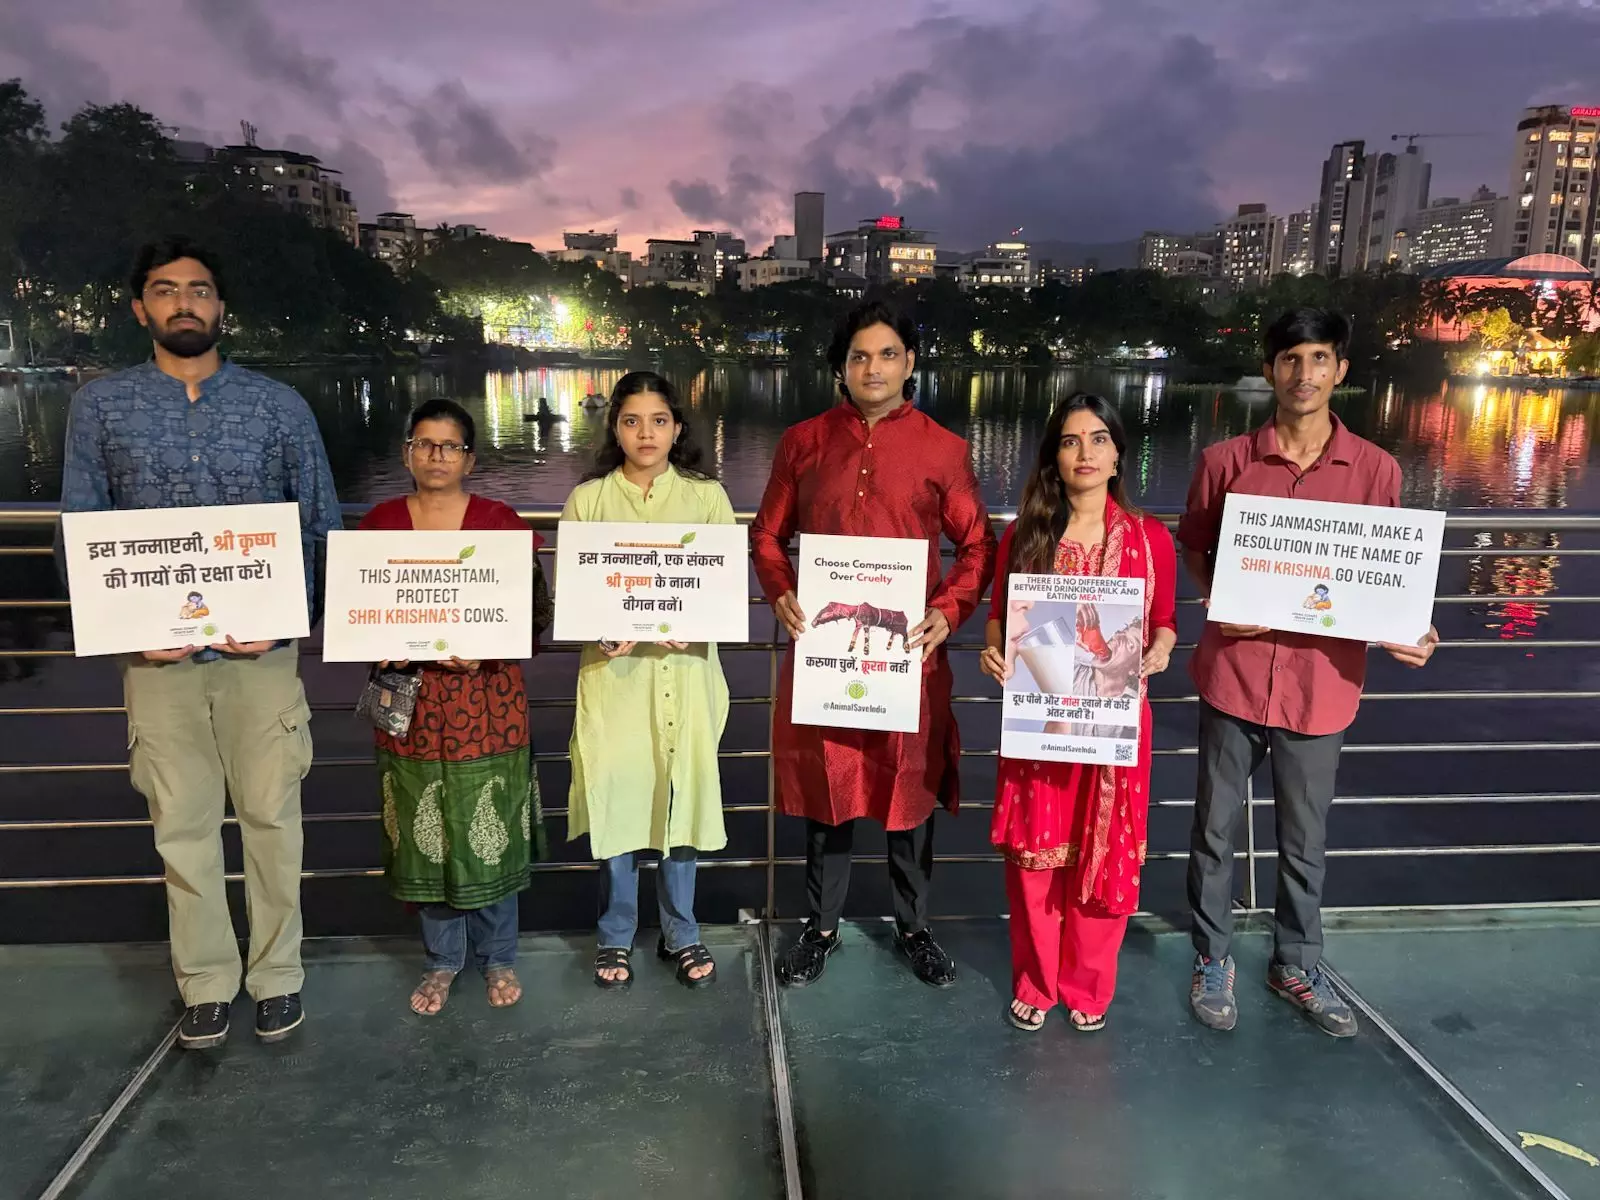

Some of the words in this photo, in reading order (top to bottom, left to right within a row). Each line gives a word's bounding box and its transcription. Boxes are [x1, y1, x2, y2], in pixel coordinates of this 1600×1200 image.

[1239, 511, 1267, 526] THIS
[1269, 514, 1367, 539] JANMASHTAMI,
[1371, 524, 1411, 541] MAKE
[1414, 528, 1424, 542] A
[87, 541, 116, 560] इस
[120, 532, 208, 556] जन्माष्टमी,
[214, 530, 234, 551] श्री
[237, 532, 277, 556] कृष्ण
[1233, 533, 1312, 555] RESOLUTION
[1315, 542, 1329, 557] IN
[1333, 544, 1358, 560] THE
[1361, 546, 1401, 564] NAME
[1404, 551, 1423, 566] OF
[578, 552, 597, 565] इस
[601, 551, 661, 567] जन्माष्टमी,
[664, 554, 684, 566] एक
[686, 552, 725, 566] संकल्प
[814, 557, 850, 568] Choose
[852, 560, 912, 571] Compassion
[103, 567, 127, 589] की
[131, 565, 172, 587] गायों
[173, 563, 196, 584] की
[199, 565, 234, 583] रक्षा
[237, 560, 271, 579] करें।
[360, 569, 391, 583] THIS
[395, 568, 499, 585] JANMASHTAMI,
[829, 572, 854, 581] Over
[856, 573, 893, 585] Cruelty
[1241, 557, 1271, 573] SHRI
[1357, 570, 1406, 588] VEGAN.
[606, 573, 621, 588] श्री
[624, 575, 652, 593] कृष्ण
[655, 574, 667, 588] के
[669, 577, 700, 589] नाम।
[1014, 583, 1052, 592] BETWEEN
[1054, 585, 1095, 593] DRINKING
[1097, 587, 1118, 595] MILK
[1026, 576, 1051, 584] THERE
[1078, 579, 1127, 587] DIFFERENCE
[396, 589, 459, 603] PROTECT
[623, 595, 655, 611] वीगन
[657, 596, 682, 611] बनें।
[1047, 592, 1077, 600] EATING
[1079, 593, 1104, 601] MEAT.
[348, 609, 381, 624] SHRI
[385, 608, 460, 624] KRISHNA'S
[464, 608, 508, 623] COWS.
[805, 655, 837, 669] करुणा
[839, 656, 858, 672] चुनें,
[861, 660, 887, 675] क्रूरता
[823, 702, 886, 714] @AnimalSaveIndia
[1012, 694, 1024, 705] दूध
[1026, 693, 1042, 704] पीने
[1044, 694, 1060, 705] और
[1061, 696, 1080, 707] मांस
[1081, 697, 1102, 708] खाने
[1103, 698, 1113, 709] में
[1113, 699, 1130, 711] कोई
[1046, 707, 1065, 717] अंतर
[1041, 744, 1097, 754] @AnimalSaveIndia
